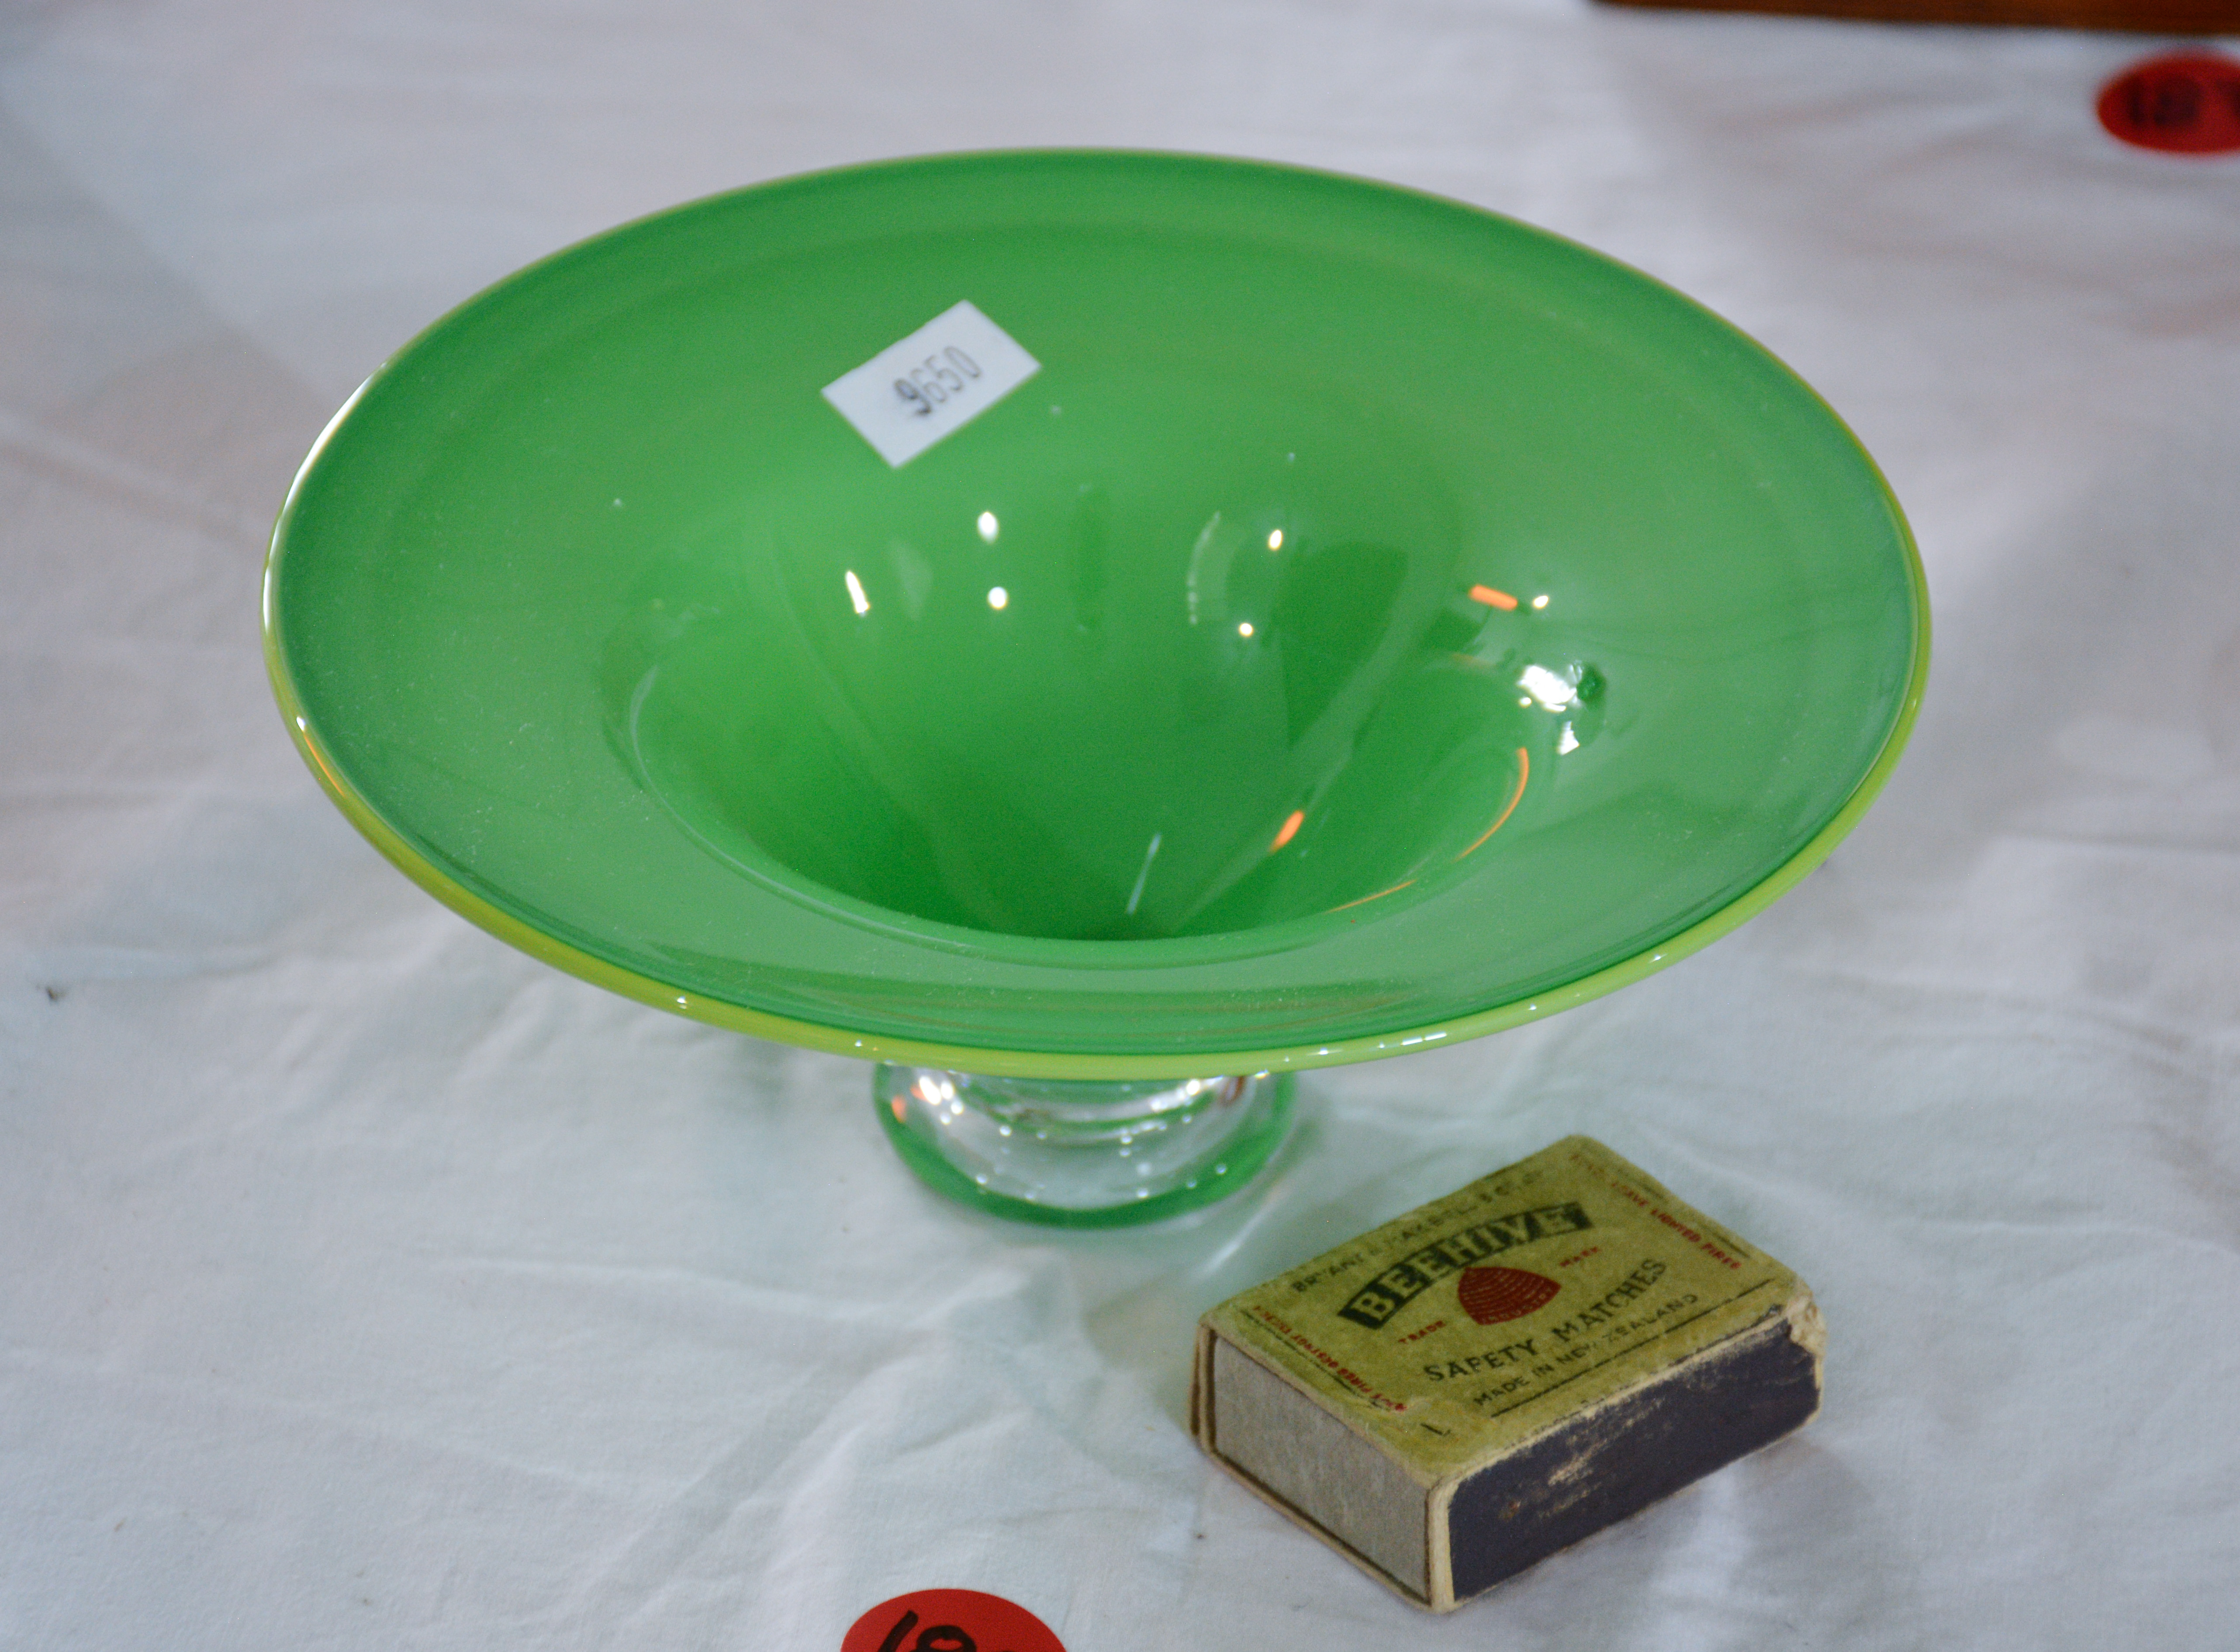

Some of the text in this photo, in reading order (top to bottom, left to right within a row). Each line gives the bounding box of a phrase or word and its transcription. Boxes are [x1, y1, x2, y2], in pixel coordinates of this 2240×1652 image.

[893, 346, 982, 416] 9650
[1345, 1204, 1580, 1321] BEEHIVE
[1559, 1246, 1602, 1268] MARK
[1398, 1319, 1446, 1345] TRADE
[1424, 1257, 1668, 1382] SAFETY MATCHES
[1473, 1293, 1700, 1407] MADE IN NEW ZEALAND
